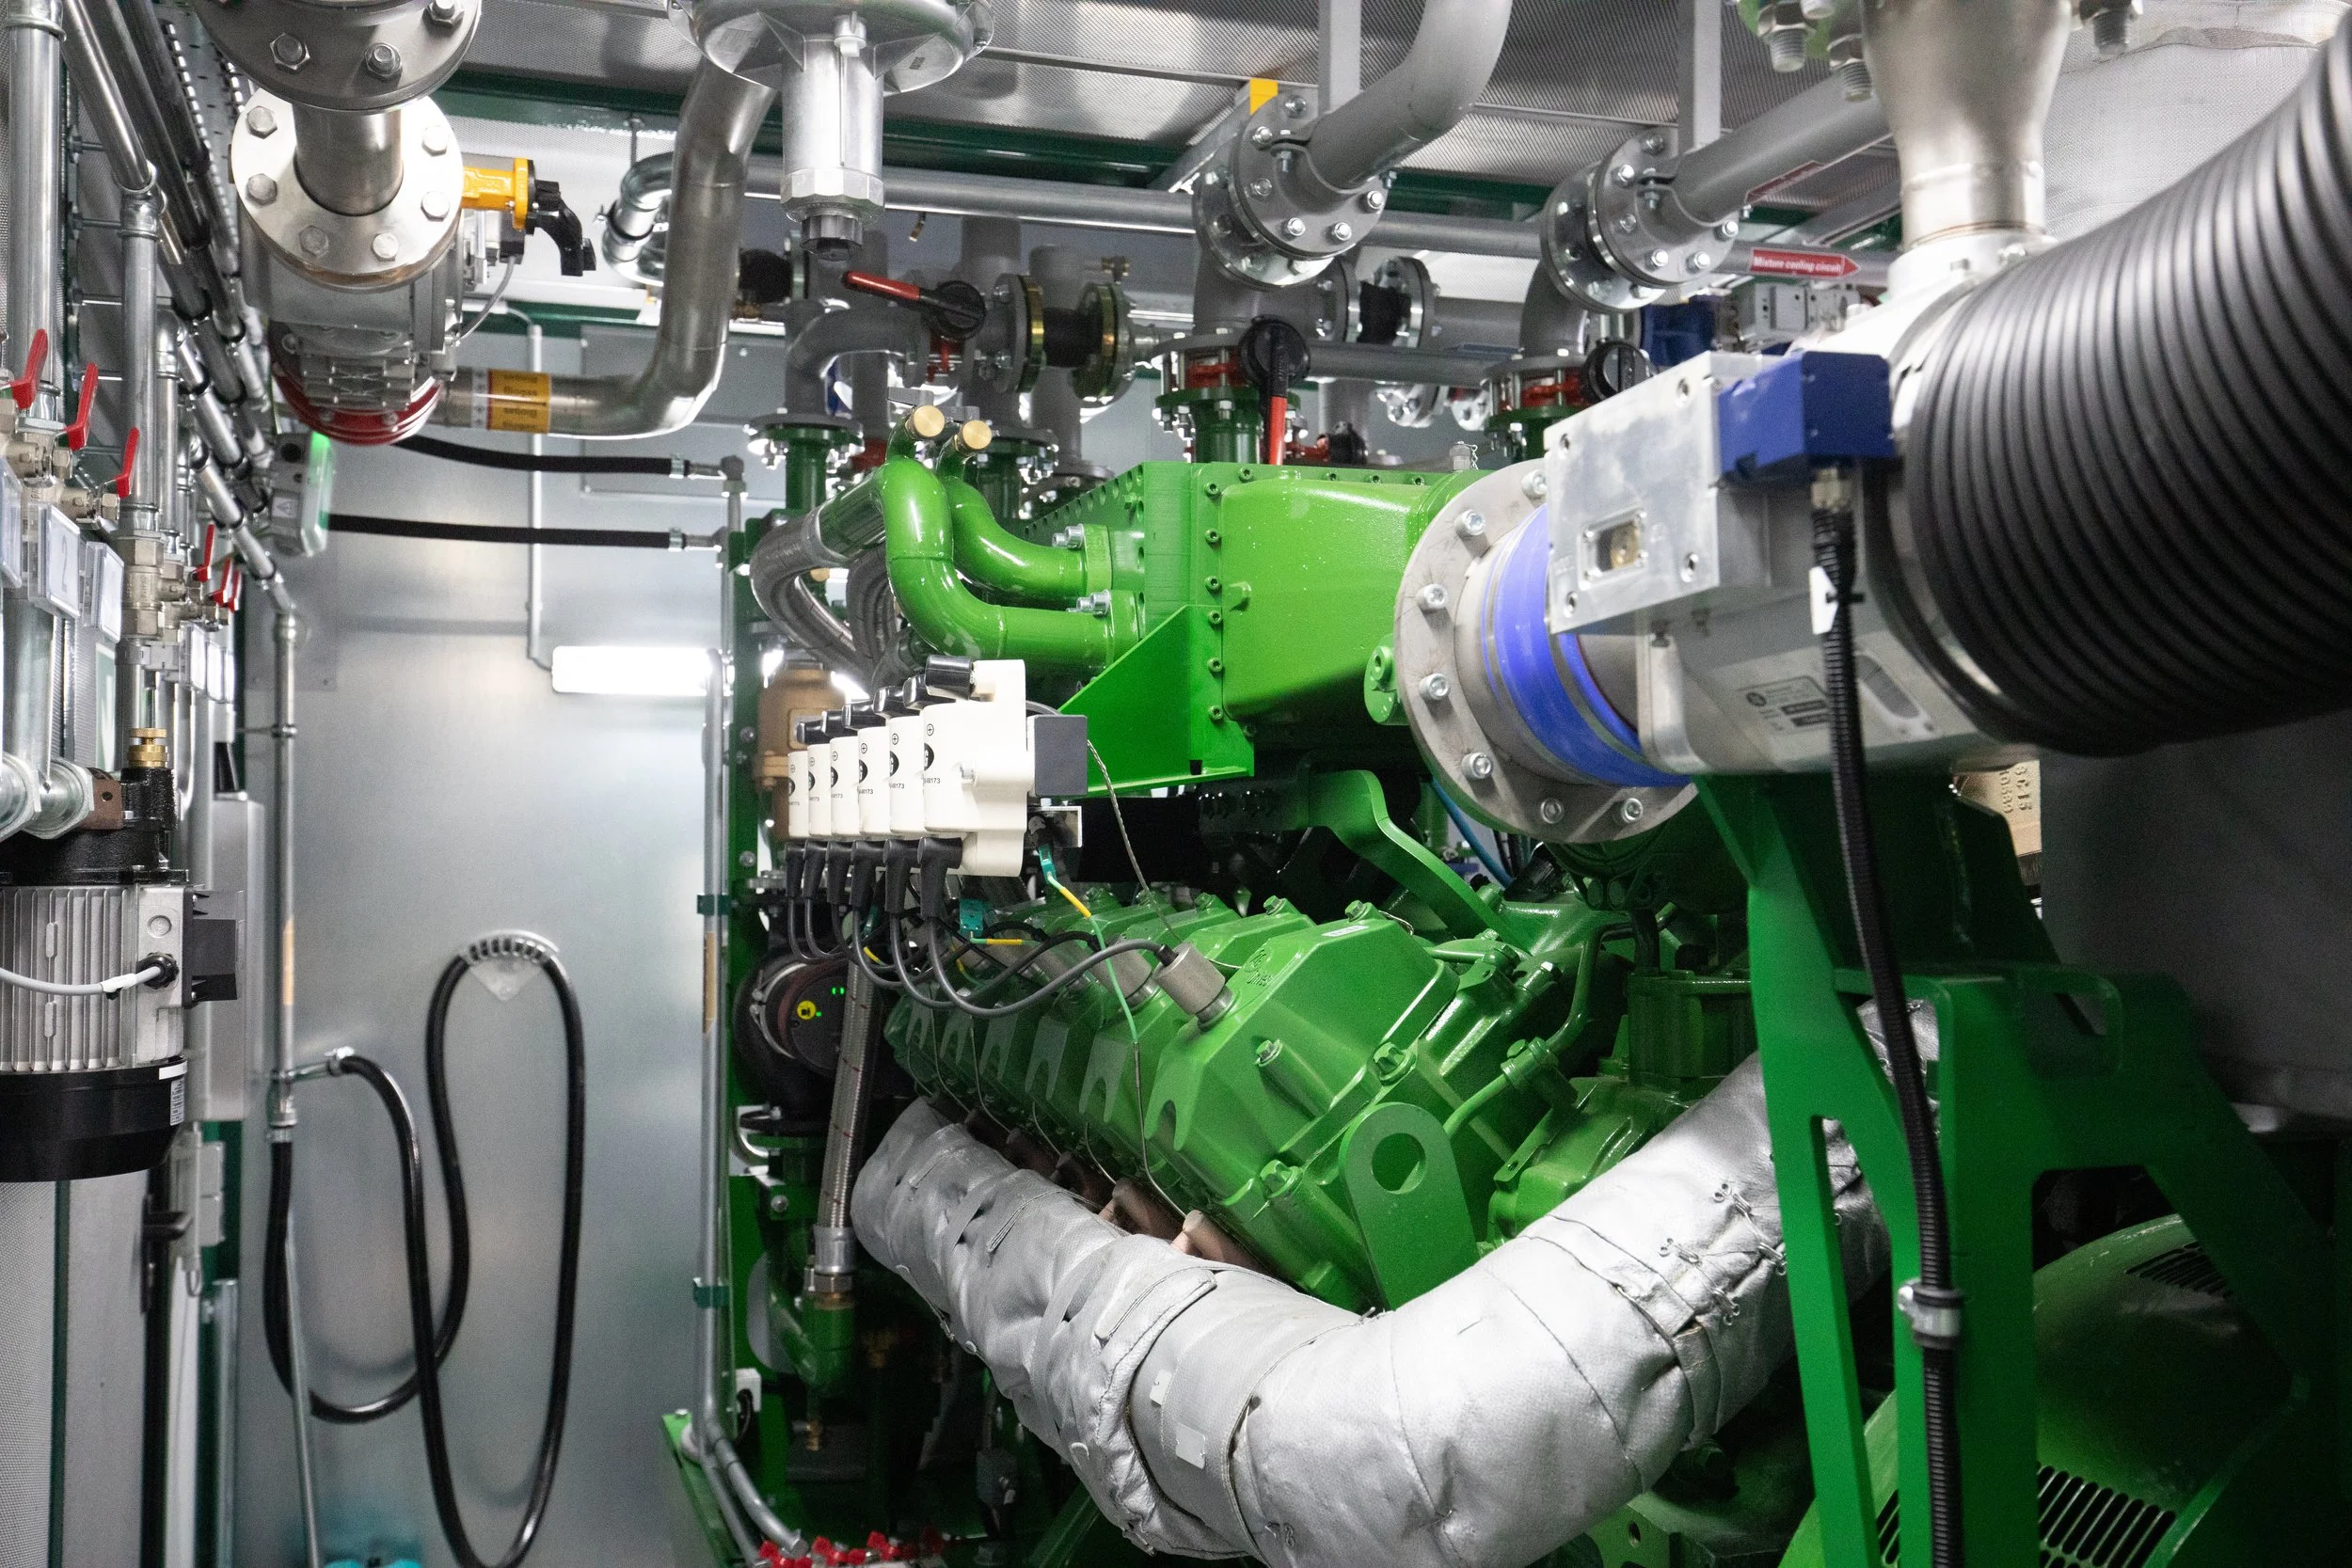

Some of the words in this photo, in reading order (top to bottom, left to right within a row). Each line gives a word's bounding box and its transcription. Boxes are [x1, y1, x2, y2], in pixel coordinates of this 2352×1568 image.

[1754, 256, 1785, 268] Mixture
[1786, 259, 1815, 272] cooling
[1815, 262, 1842, 273] circuit
